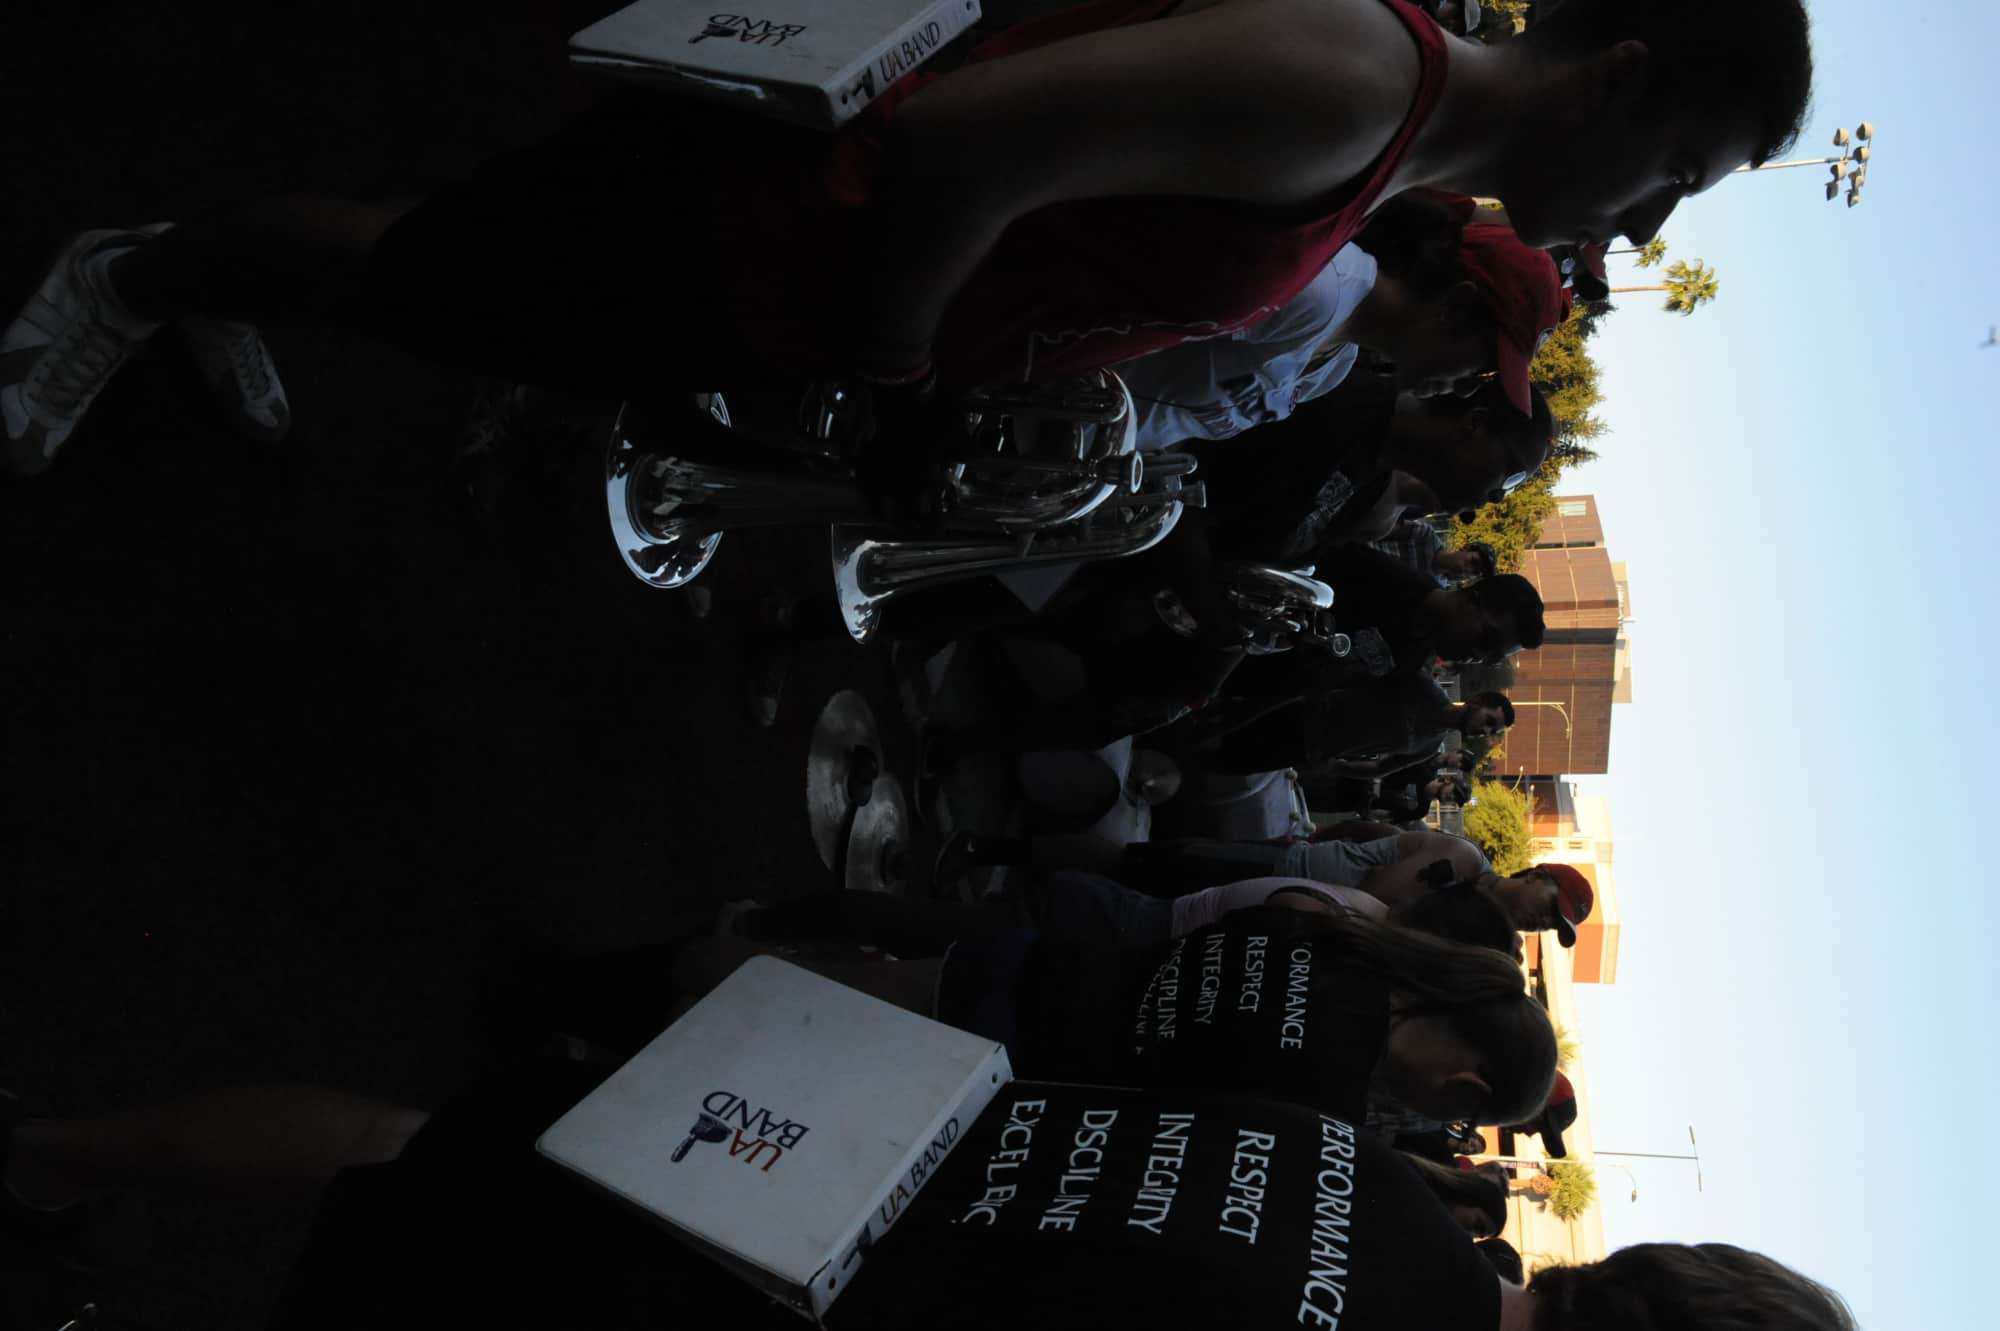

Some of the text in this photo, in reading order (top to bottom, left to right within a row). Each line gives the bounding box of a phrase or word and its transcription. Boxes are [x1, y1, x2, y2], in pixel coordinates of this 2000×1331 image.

[709, 14, 806, 36] BAND
[900, 22, 940, 67] BAND
[1193, 932, 1226, 1025] INTEGRITY
[1237, 936, 1269, 1014] RESPECT
[1280, 942, 1313, 1049] ORMANCE
[702, 1091, 810, 1150] BAND
[728, 1128, 783, 1172] UA
[879, 1117, 960, 1225] UA BAND
[1218, 1129, 1278, 1246] RESPECT
[1296, 1114, 1356, 1331] PERFORMANCE
